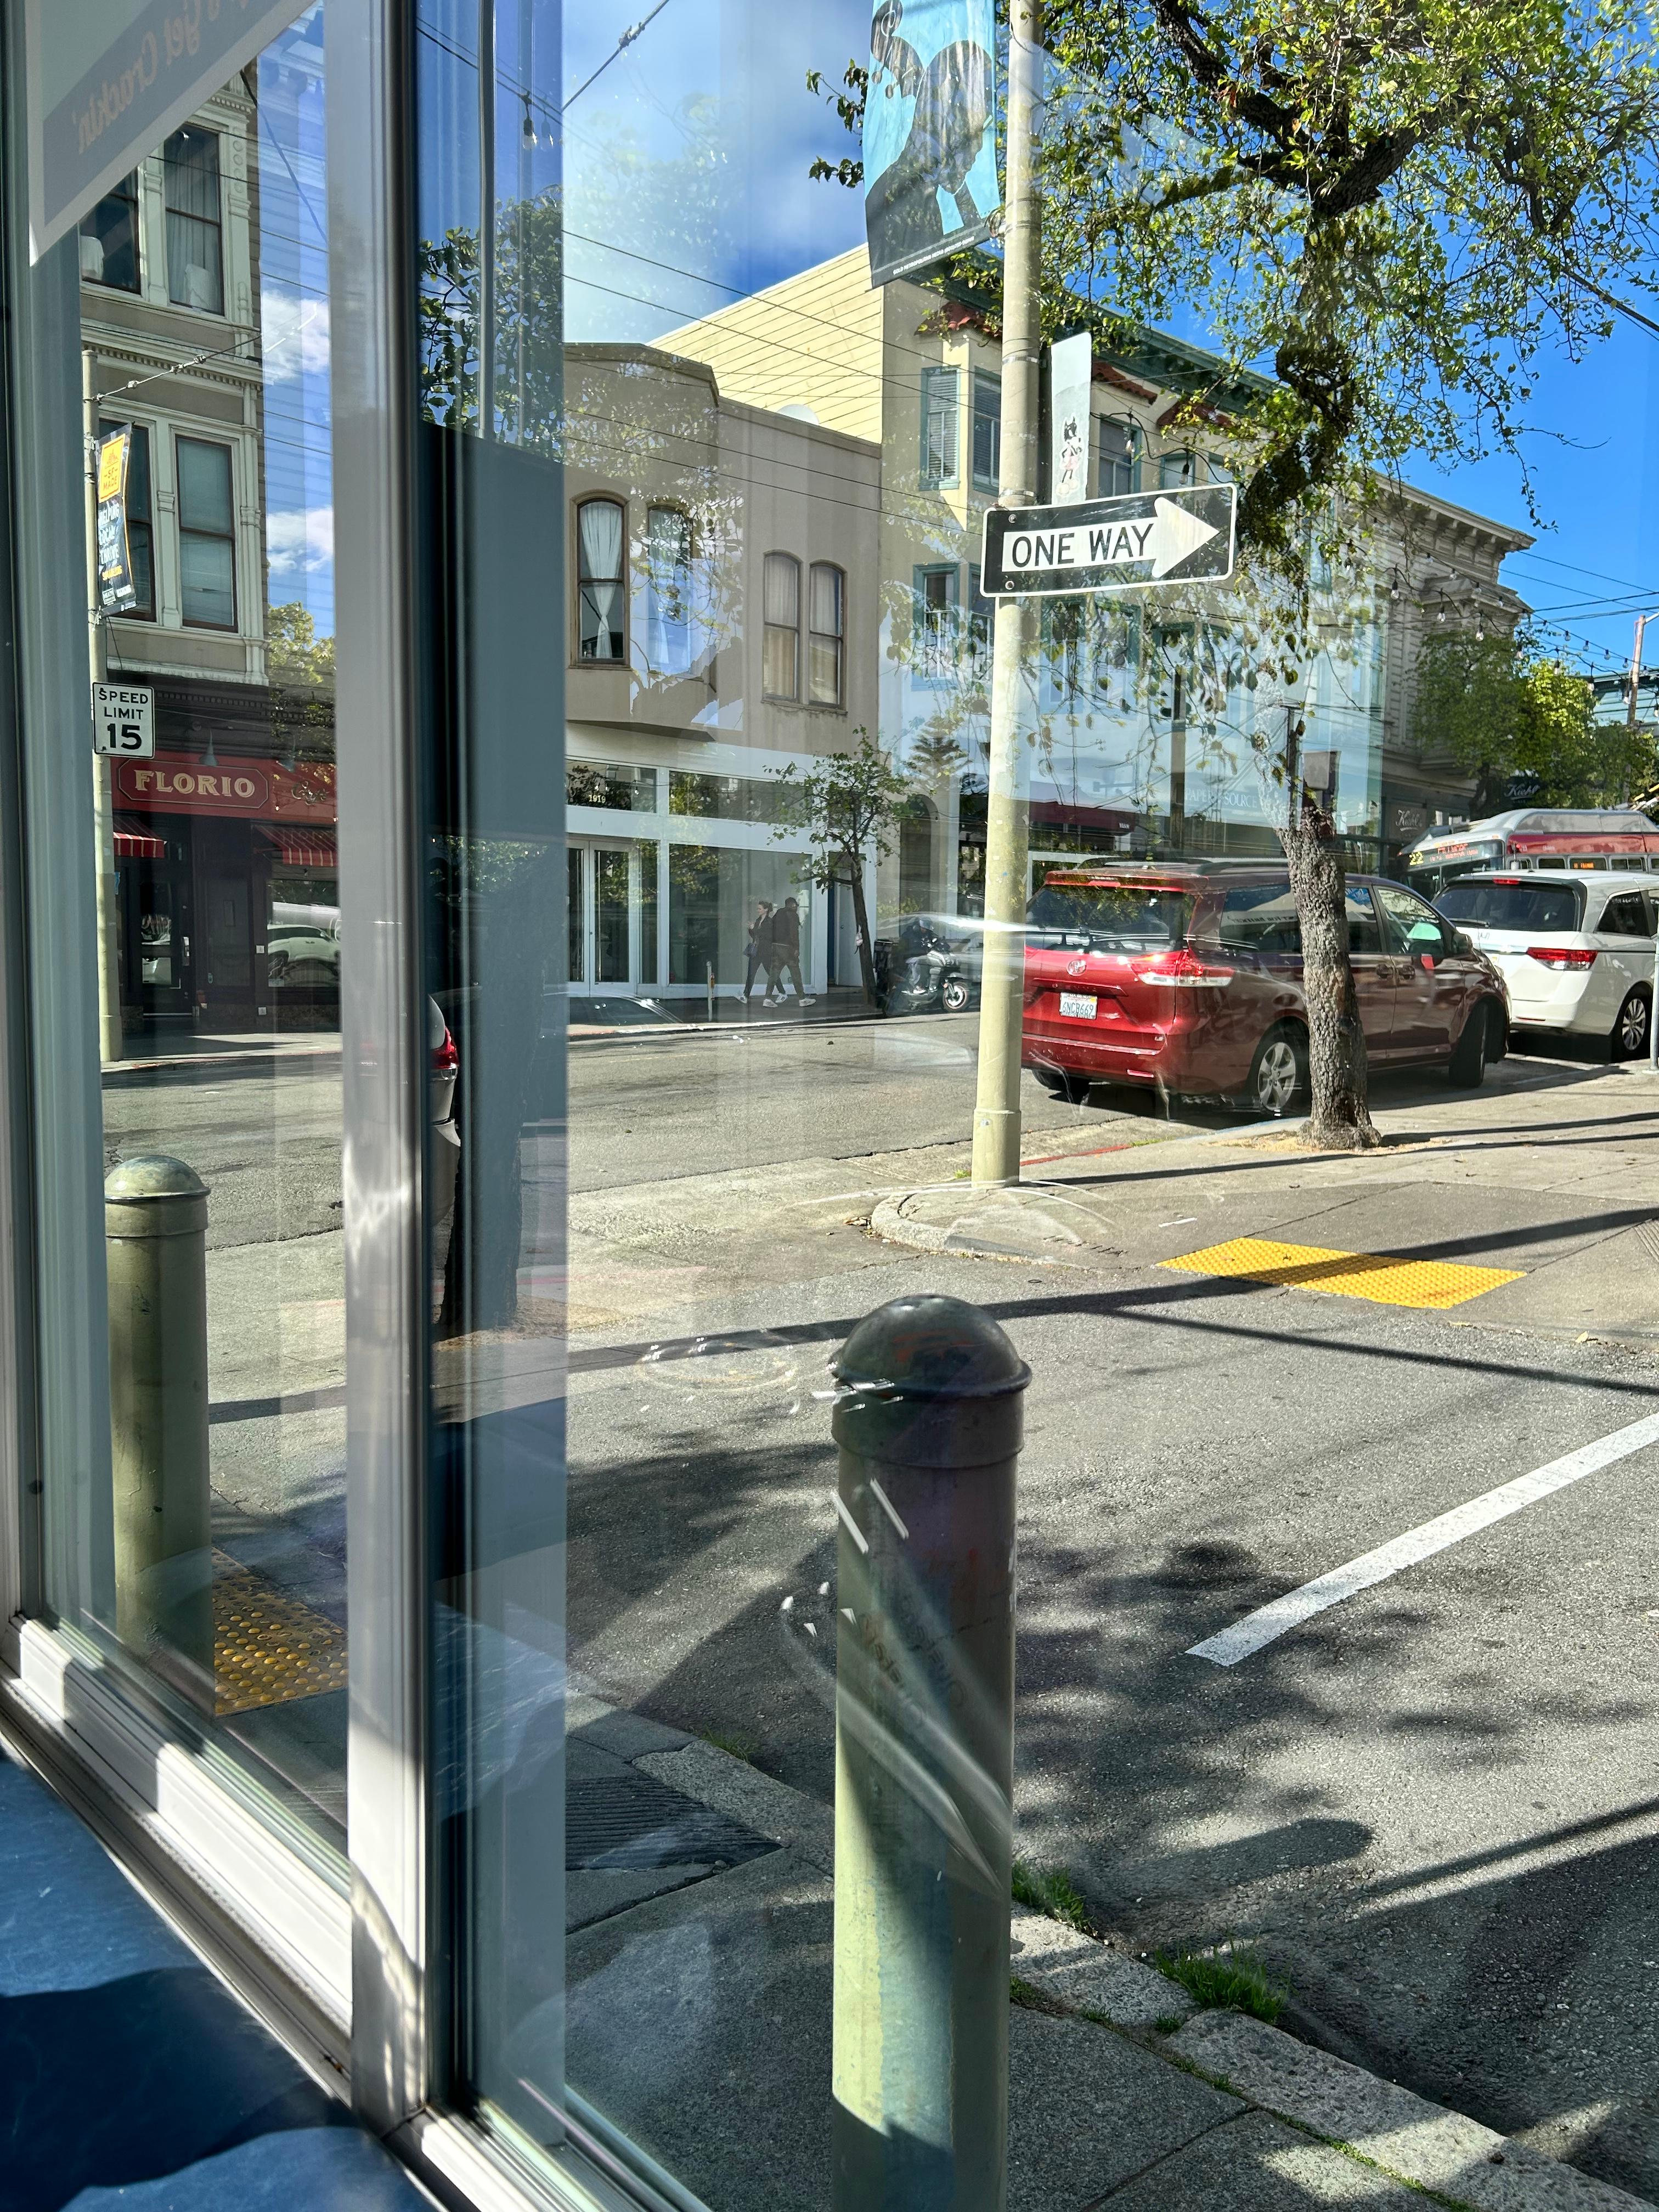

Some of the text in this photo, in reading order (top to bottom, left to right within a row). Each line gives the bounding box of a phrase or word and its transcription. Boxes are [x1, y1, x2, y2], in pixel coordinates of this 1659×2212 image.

[1012, 523, 1154, 568] ONE WAY
[99, 543, 119, 565] THRIVE
[99, 690, 148, 704] SPEED
[104, 706, 144, 720] LIMIT
[107, 723, 142, 750] 15
[133, 769, 255, 798] FLORIO
[588, 794, 606, 804] 1919
[1224, 793, 1257, 808] SOURCE
[1409, 851, 1424, 866] 22
